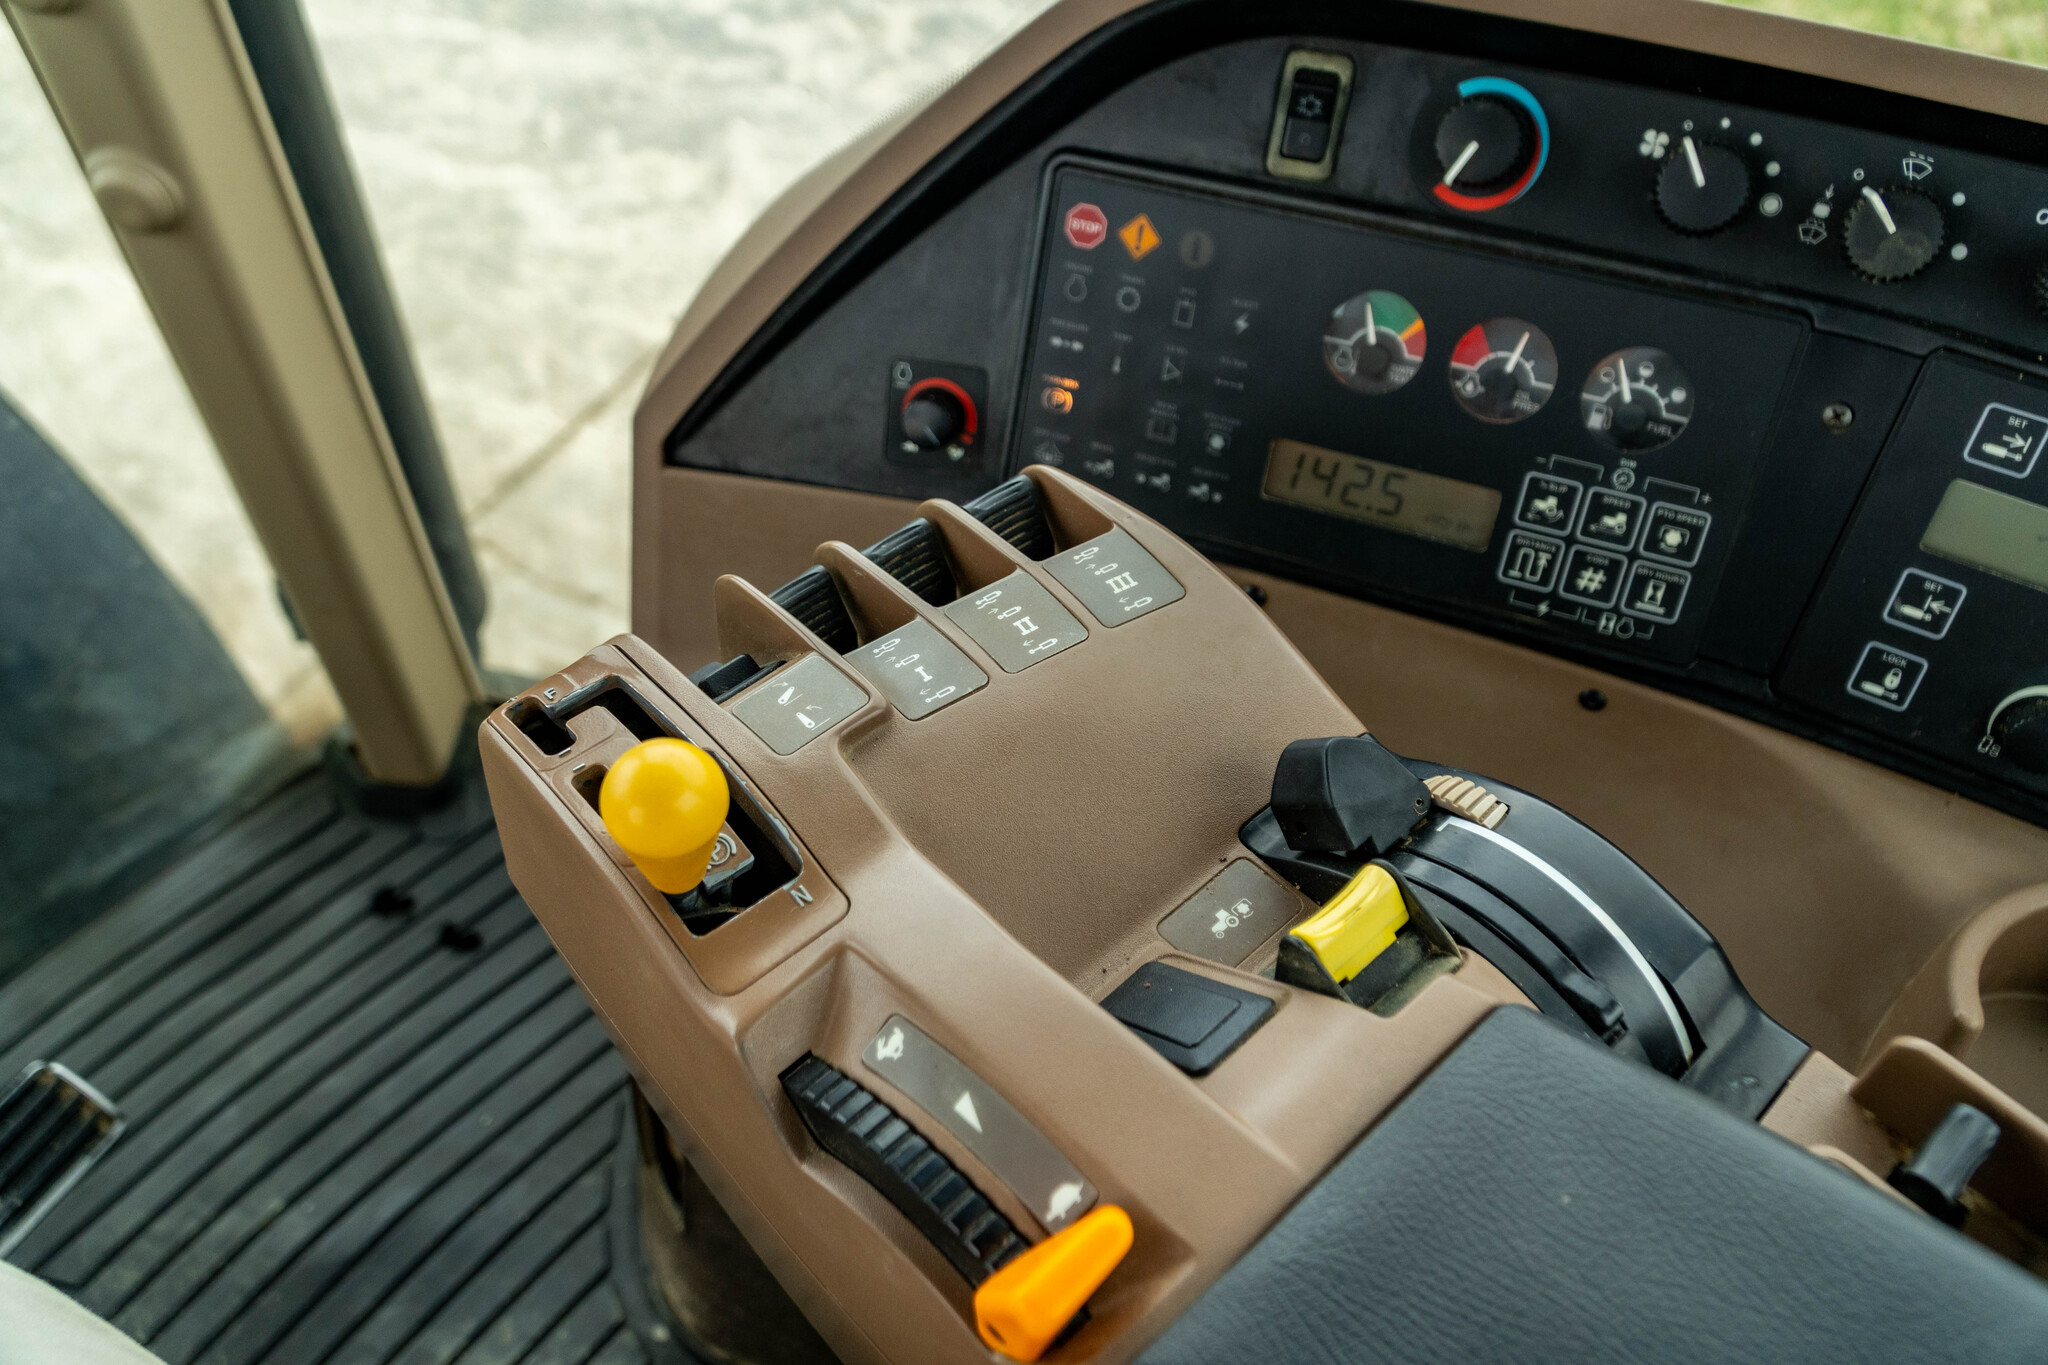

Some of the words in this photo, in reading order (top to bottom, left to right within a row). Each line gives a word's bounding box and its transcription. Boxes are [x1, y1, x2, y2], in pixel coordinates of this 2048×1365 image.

[1071, 217, 1103, 234] STOP
[1647, 420, 1672, 438] FUEL
[2008, 415, 2029, 430] SET
[1620, 457, 1637, 470] DIM
[1290, 453, 1407, 517] 142.5
[1602, 494, 1632, 509] SPEED
[1657, 507, 1676, 520] PTO
[1676, 511, 1705, 527] SPEED
[1923, 580, 1944, 593] SET
[1882, 651, 1908, 669] LOCK
[543, 687, 557, 700] F
[790, 884, 813, 907] N
